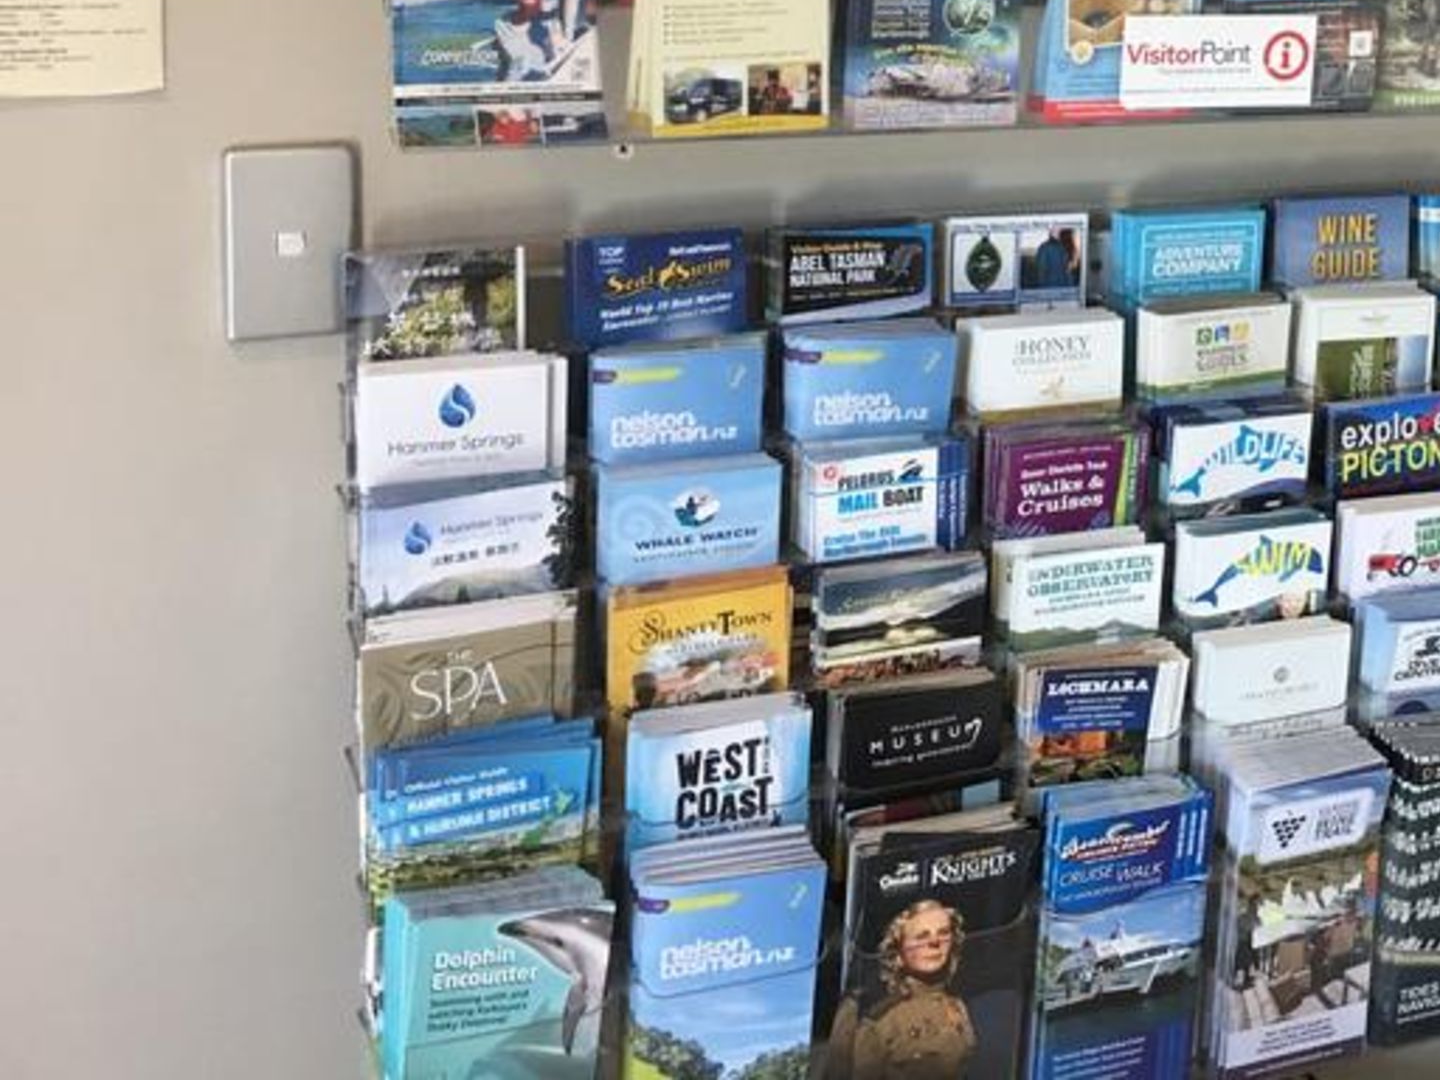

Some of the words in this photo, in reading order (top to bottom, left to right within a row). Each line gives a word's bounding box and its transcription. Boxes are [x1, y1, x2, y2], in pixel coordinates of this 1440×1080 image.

[1127, 40, 1252, 66] VisitorPoint
[1317, 214, 1378, 244] WINE
[790, 252, 826, 272] ABEL
[829, 250, 886, 268] TASMAN
[1155, 242, 1244, 263] ADVENTURE
[1311, 248, 1379, 278] GUIDE
[790, 270, 843, 288] NATIONAL
[846, 268, 876, 284] PARK
[1153, 258, 1243, 278] COMPANY
[1018, 335, 1091, 356] HONEY
[813, 403, 929, 426] tasman.nz
[814, 391, 891, 414] nelson
[611, 410, 696, 434] nelson
[388, 434, 456, 456] Hanmer
[460, 431, 525, 453] Springs
[610, 425, 738, 450] tasman.nz
[838, 469, 894, 491] PELORUS
[1021, 477, 1081, 499] Walks
[1088, 476, 1104, 493] &
[838, 493, 878, 514] MAIL
[884, 486, 922, 507] BOAT
[1018, 494, 1103, 518] Cruises
[634, 532, 694, 551] WHALE
[700, 526, 757, 545] WATCH
[1029, 556, 1154, 583] UNDERWATER
[1027, 571, 1154, 597] OBSERVATORY
[447, 649, 473, 661] THE
[411, 662, 508, 720] SPA
[1047, 680, 1149, 696] LOCHMARA
[869, 718, 983, 755] MUSEUM
[677, 740, 762, 788] WEST
[468, 778, 528, 802] SPRINGS
[485, 797, 551, 822] DISTRICT
[677, 777, 774, 830] COAST
[931, 851, 1016, 887] KNIGHTS
[1060, 864, 1112, 888] CRUISE
[1117, 861, 1164, 883] WALK
[436, 948, 517, 973] Dolphin
[661, 936, 751, 963] nelson
[660, 946, 797, 980] tasman.nz
[432, 966, 537, 993] Encounter
[1400, 982, 1440, 1001] TIDES
